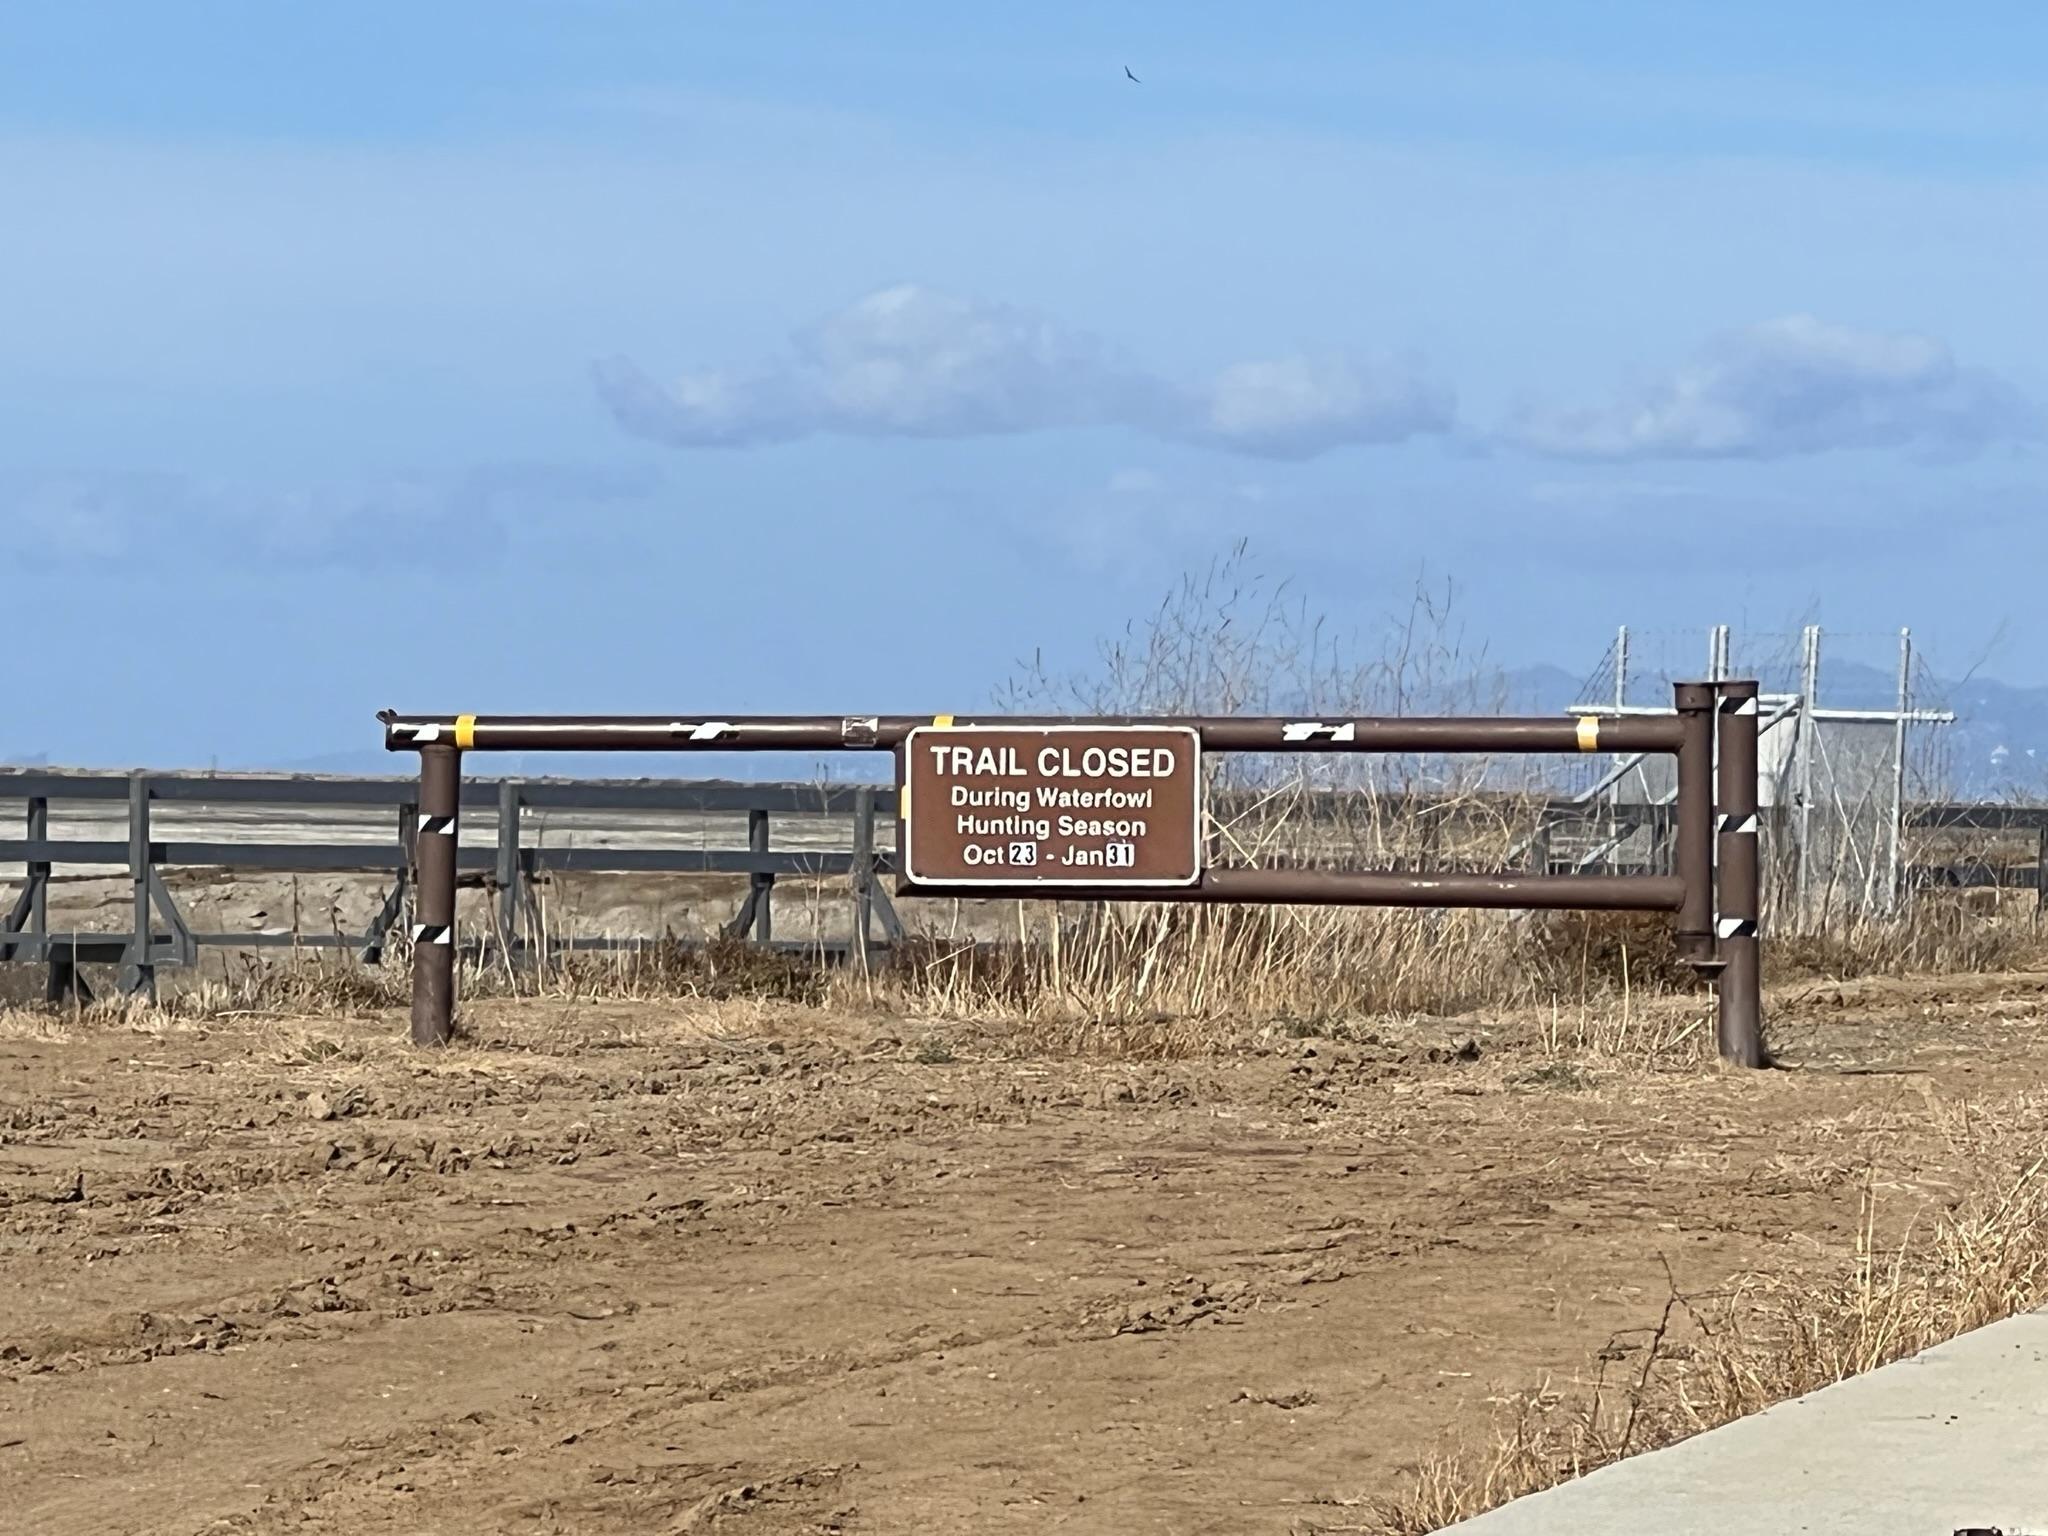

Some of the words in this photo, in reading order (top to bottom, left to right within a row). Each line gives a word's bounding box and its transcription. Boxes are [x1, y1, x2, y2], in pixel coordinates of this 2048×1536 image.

[930, 746, 1027, 776] TRAIL
[1037, 747, 1175, 777] CLOSED
[951, 785, 1030, 812] During
[1036, 787, 1153, 809] Waterfowl
[957, 814, 1050, 840] Hunting
[1058, 815, 1146, 837] Season
[963, 844, 1004, 866] Oct
[1011, 844, 1035, 863] 23
